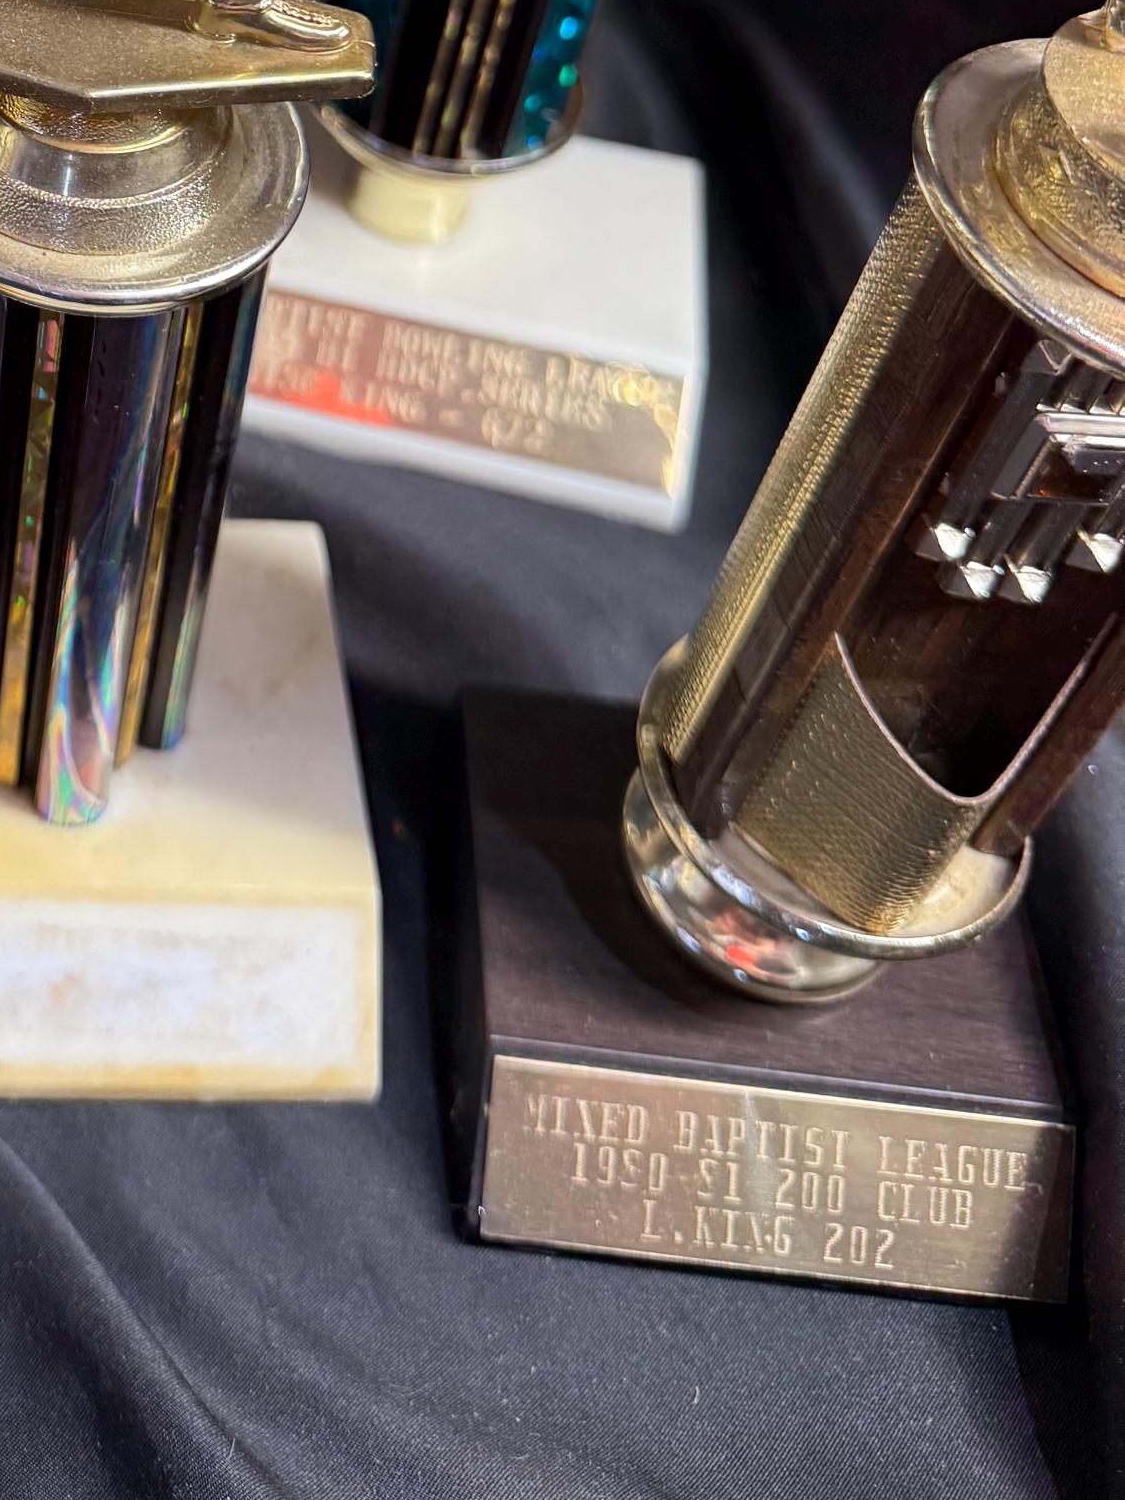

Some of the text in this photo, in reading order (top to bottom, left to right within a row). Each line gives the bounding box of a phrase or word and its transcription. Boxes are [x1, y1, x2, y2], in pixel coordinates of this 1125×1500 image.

[524, 1093, 1028, 1192] MIXED BAPTIST LEAGUE
[775, 1168, 846, 1213] 200
[878, 1180, 974, 1229] CLUB
[823, 1222, 895, 1269] 202
